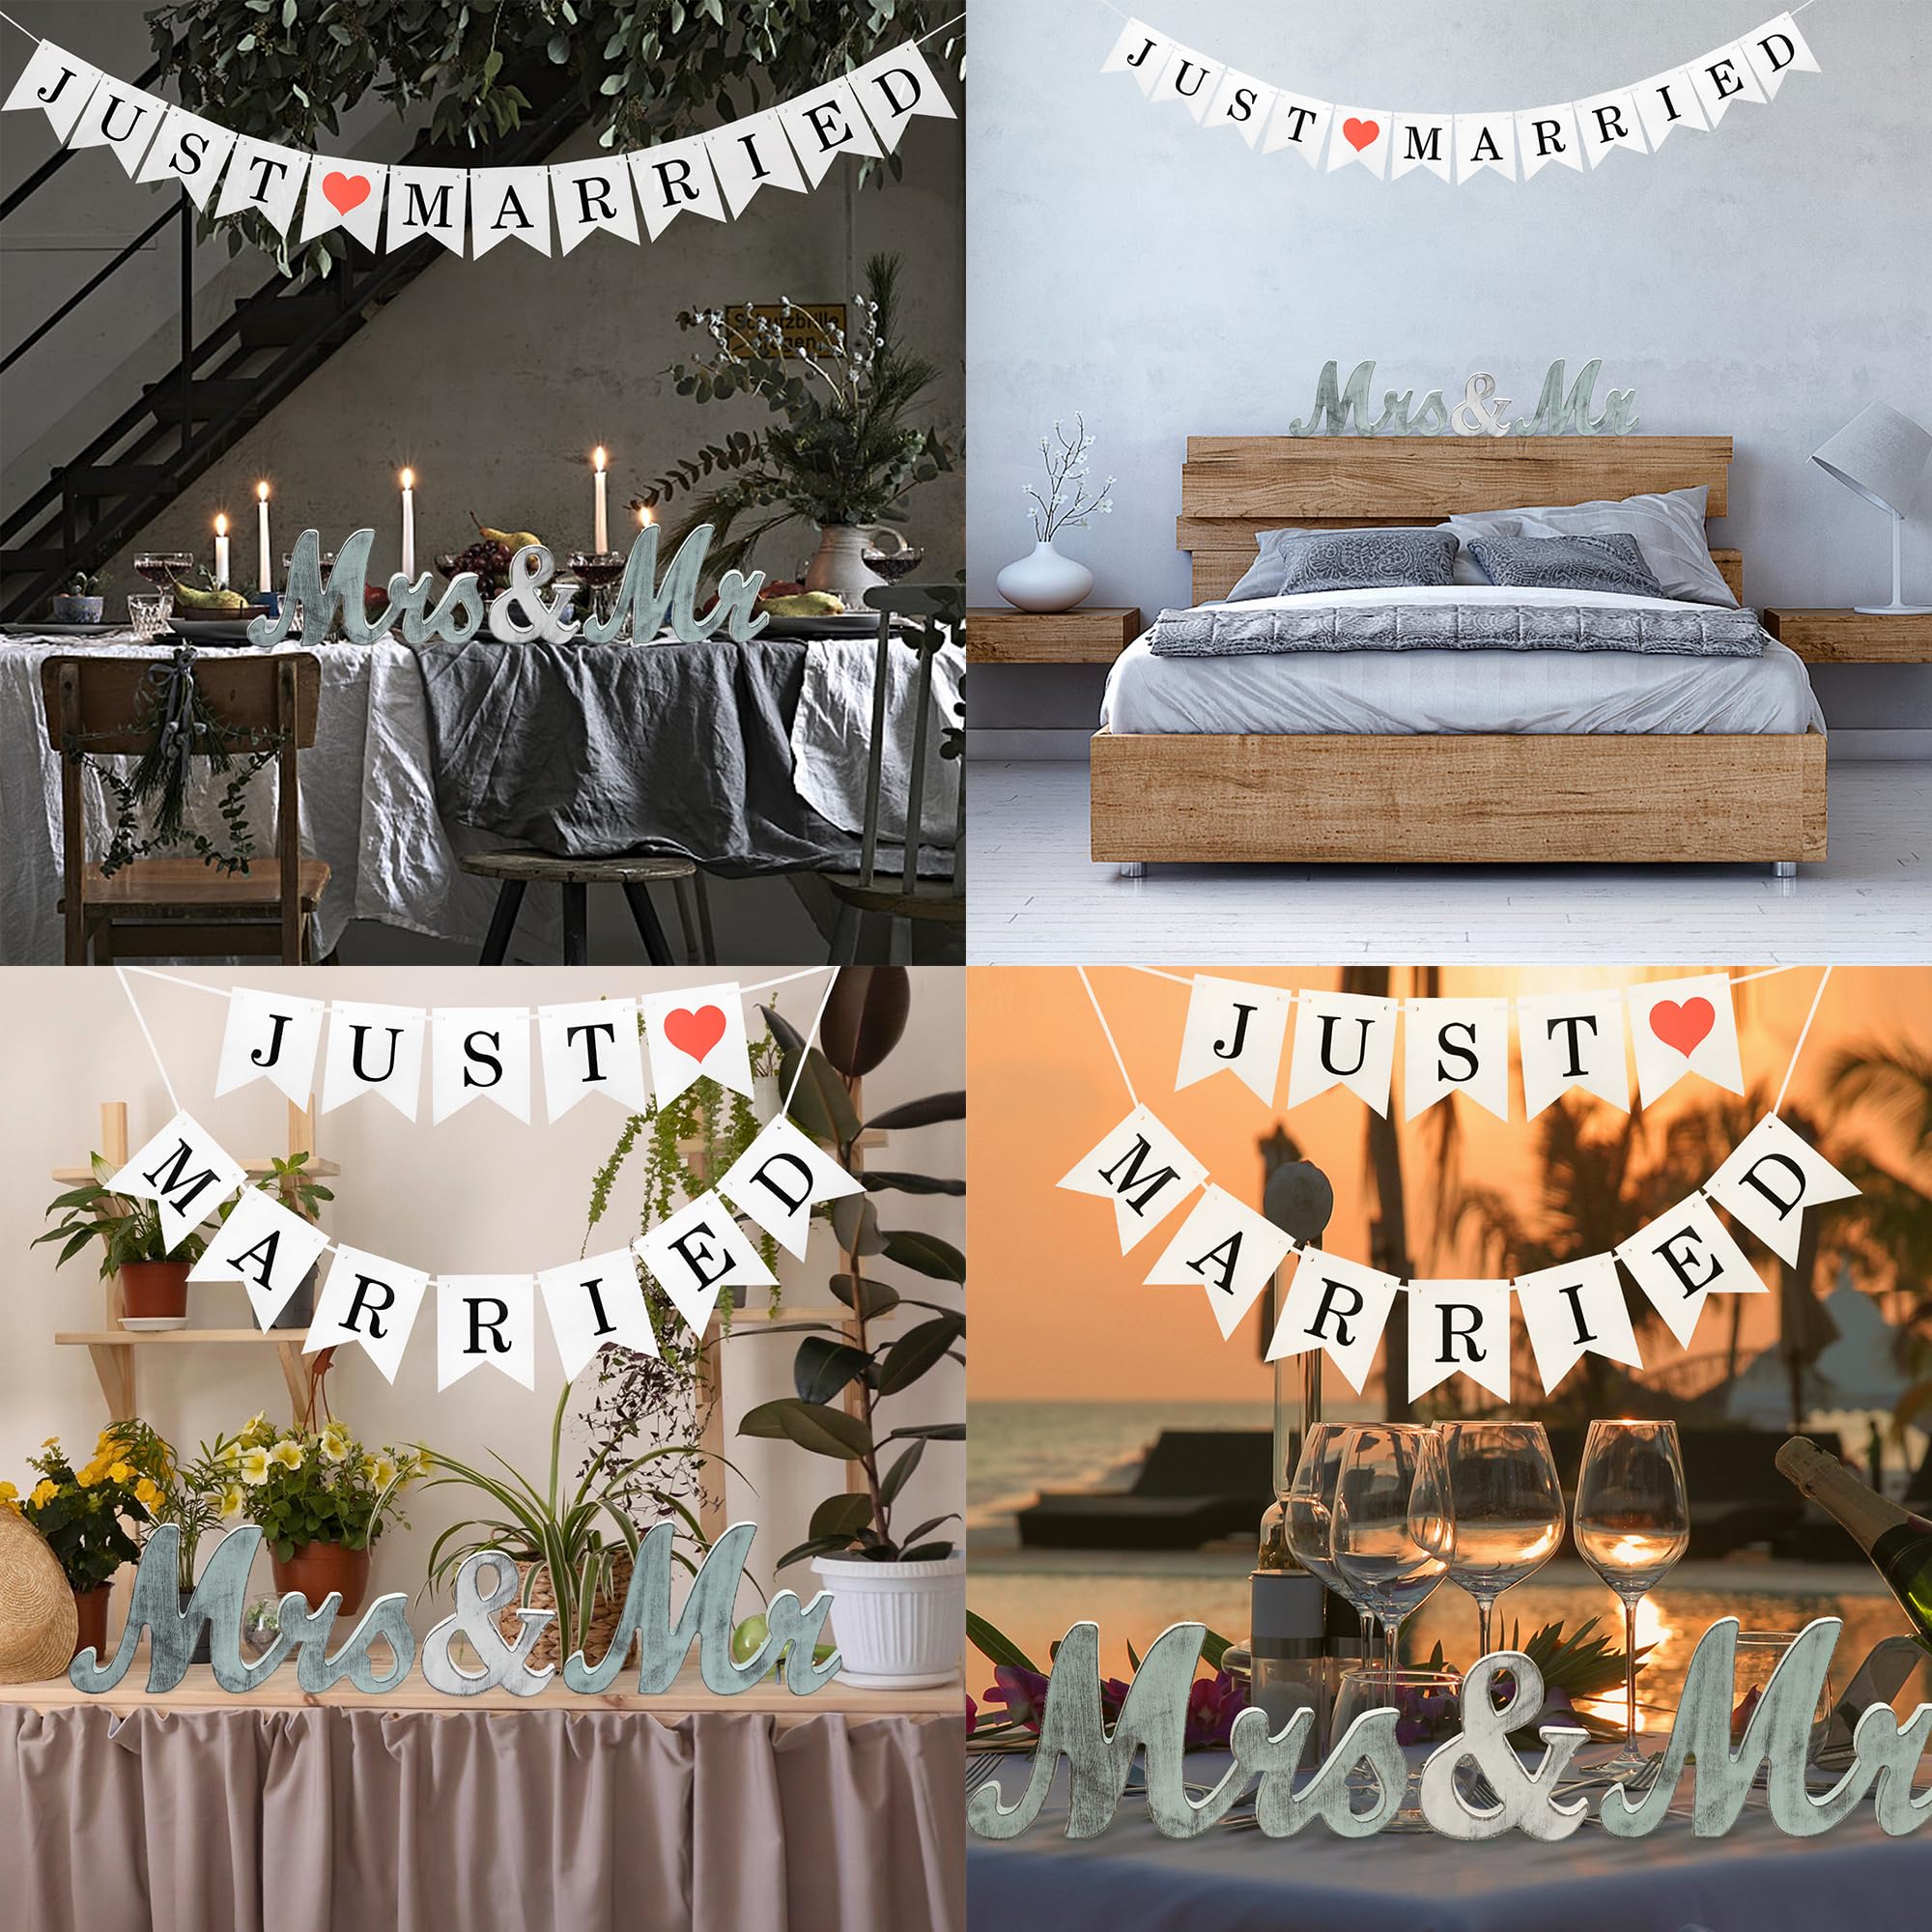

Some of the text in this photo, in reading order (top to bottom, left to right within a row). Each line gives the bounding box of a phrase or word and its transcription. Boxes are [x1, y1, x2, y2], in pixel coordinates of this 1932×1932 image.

[37, 66, 923, 230] JUST MARRIED
[1127, 32, 1796, 162] JUST MARRIED
[734, 312, 839, 329] Scutzbrille
[1289, 359, 1447, 438] Mrs
[1515, 357, 1639, 438] Mr
[247, 528, 480, 647] Mrs
[583, 523, 771, 644] Mr
[250, 1013, 615, 1088] JUST
[1213, 1003, 1597, 1081] JUST
[143, 1138, 815, 1354] MARRIED
[1097, 1133, 1806, 1363] MARRIED
[69, 1522, 416, 1695] Mrs
[564, 1520, 842, 1696] Mr
[966, 1621, 1407, 1840] Mrs
